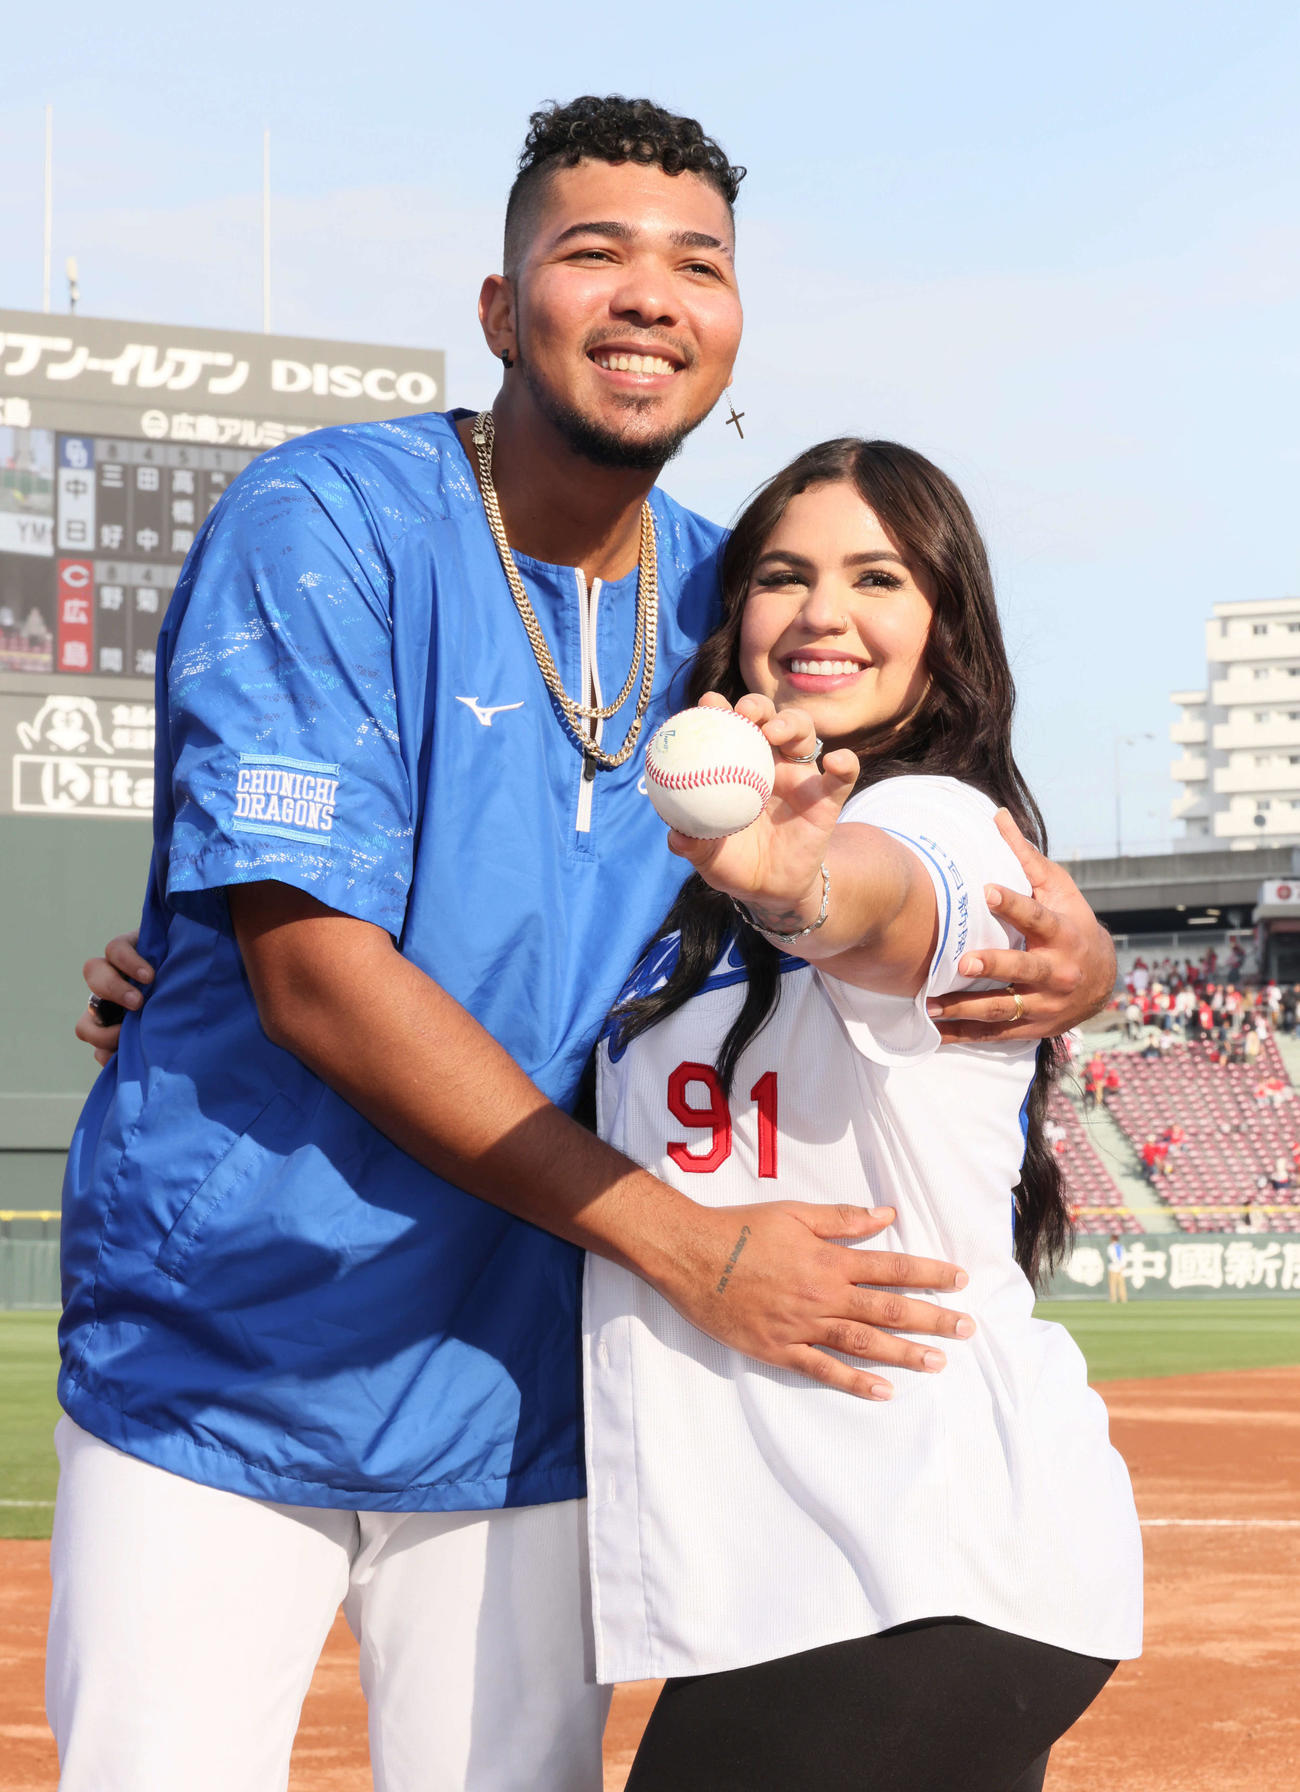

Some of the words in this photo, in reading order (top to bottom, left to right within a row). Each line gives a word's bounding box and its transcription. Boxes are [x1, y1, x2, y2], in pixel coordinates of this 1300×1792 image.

[271, 358, 438, 405] DISCO
[65, 478, 88, 542] 中日
[236, 769, 339, 806] CHUNICHI
[233, 793, 334, 831] DRAGONS
[667, 1061, 778, 1179] 91
